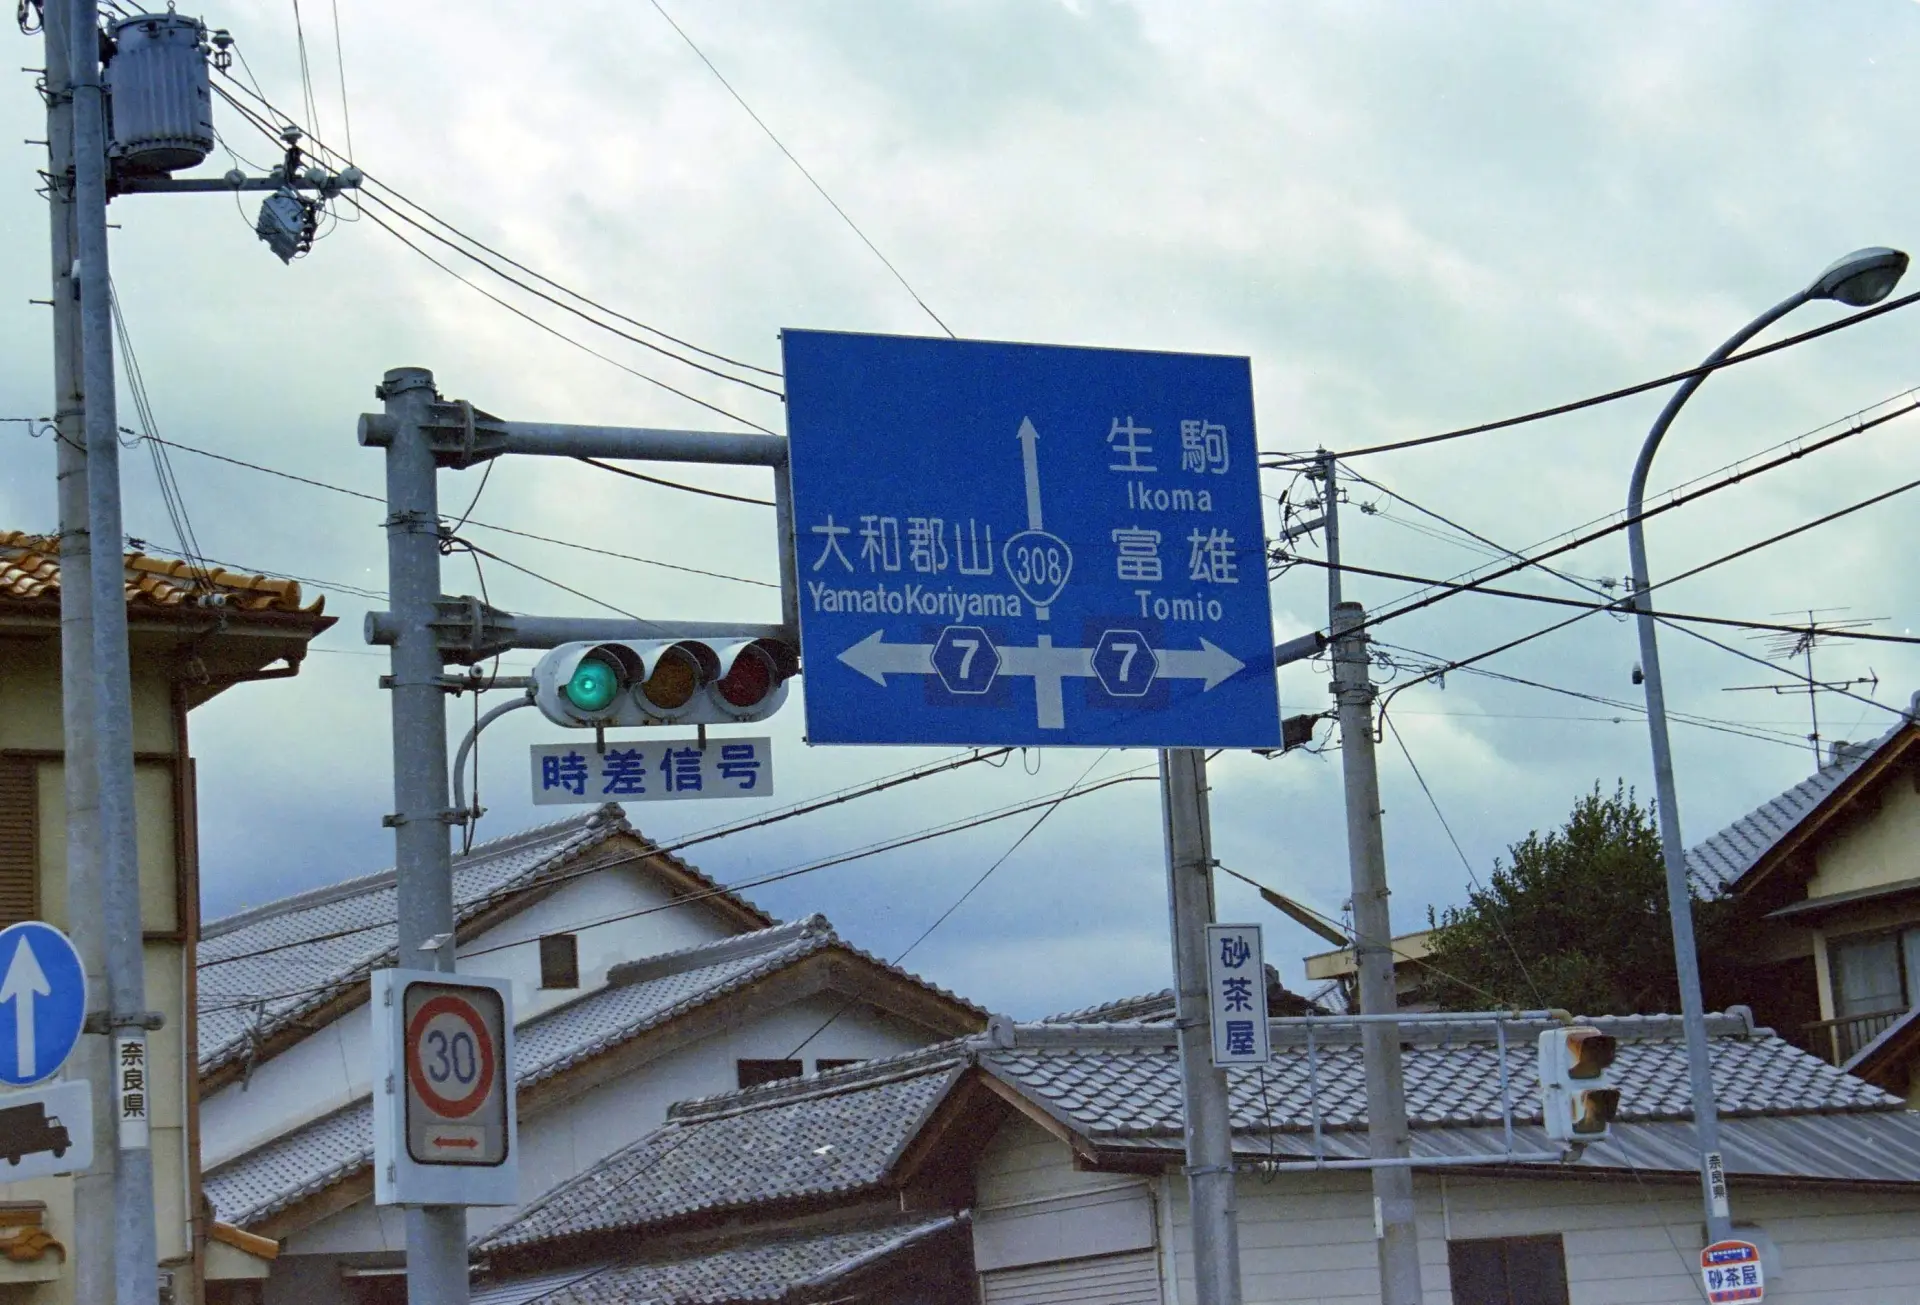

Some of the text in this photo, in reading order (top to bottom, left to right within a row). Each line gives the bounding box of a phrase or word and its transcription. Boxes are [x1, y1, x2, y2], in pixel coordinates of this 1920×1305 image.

[1106, 416, 1230, 475] 生駒
[1127, 481, 1213, 512] Ikoma
[811, 514, 993, 575] 大和郡山
[1017, 547, 1062, 585] 308
[1111, 527, 1239, 584] 富雄
[1134, 590, 1223, 621] Tomio
[952, 639, 980, 679] 7
[1111, 643, 1138, 682] 7
[542, 744, 761, 795] 時差信号
[1220, 936, 1256, 1055] 砂茶屋
[121, 1042, 146, 1118] 奈良県
[428, 1030, 476, 1084] 30
[1708, 1155, 1724, 1199] 奈良県
[1707, 1265, 1758, 1290] 砂茶屋
